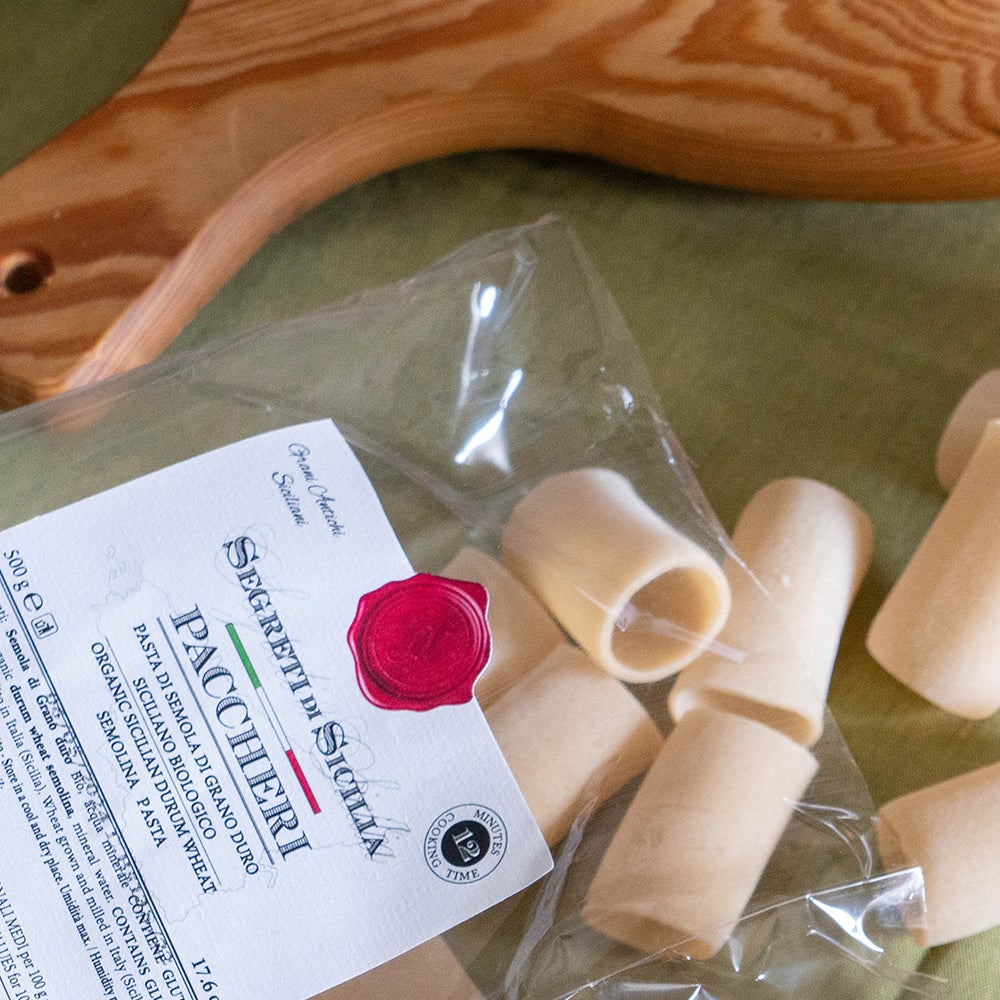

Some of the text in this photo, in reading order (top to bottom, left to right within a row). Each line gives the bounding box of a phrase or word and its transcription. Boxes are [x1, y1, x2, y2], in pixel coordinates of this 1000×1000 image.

[271, 471, 309, 527] Siciliani
[288, 443, 346, 536] Grani Antichi
[3, 550, 28, 577] 500
[12, 580, 29, 592] g
[5, 628, 30, 672] Semola
[27, 677, 41, 690] di
[35, 694, 58, 731] Grano
[54, 734, 74, 765] duro
[222, 535, 389, 860] SEGRETI DI SICILIA
[133, 623, 260, 875] PASTA DI SEMOLA DI GRANO DURO
[169, 603, 313, 862] PACCHERI
[1, 758, 18, 783] Store
[91, 642, 218, 894] ORGANIC SICILIAN DURUM WHEAT
[132, 677, 217, 840] SICILIANO BIOLOGICO
[12, 782, 24, 795] in
[96, 710, 140, 790] SEMOLINA
[136, 796, 167, 849] PASTA
[9, 684, 32, 724] durum
[29, 725, 51, 762] wheat
[45, 764, 75, 819] semolina,
[72, 822, 101, 866] mineral
[94, 869, 114, 904] water.
[111, 906, 151, 976] CONTAINS
[21, 802, 39, 823] cool
[5, 718, 24, 749] Italia
[18, 749, 47, 795] (Sicilia).
[42, 795, 64, 834] Wheat
[55, 835, 80, 872] grown
[75, 873, 94, 896] and
[86, 896, 111, 933] milled
[102, 932, 114, 946] in
[109, 945, 127, 972] Italy
[30, 822, 47, 841] and
[38, 840, 52, 857] dry
[427, 812, 480, 881] COOKING TIME
[452, 826, 480, 863] 12
[474, 809, 503, 857] MINUTES
[43, 857, 63, 886] place.
[59, 883, 84, 924] Umidità
[5, 917, 29, 951] MEDI
[76, 923, 91, 947] max.
[16, 951, 35, 969] per
[89, 950, 115, 996] Humidity
[191, 957, 218, 993] 17.6
[7, 972, 21, 989] for
[28, 969, 46, 990] 100
[33, 990, 47, 1000] g
